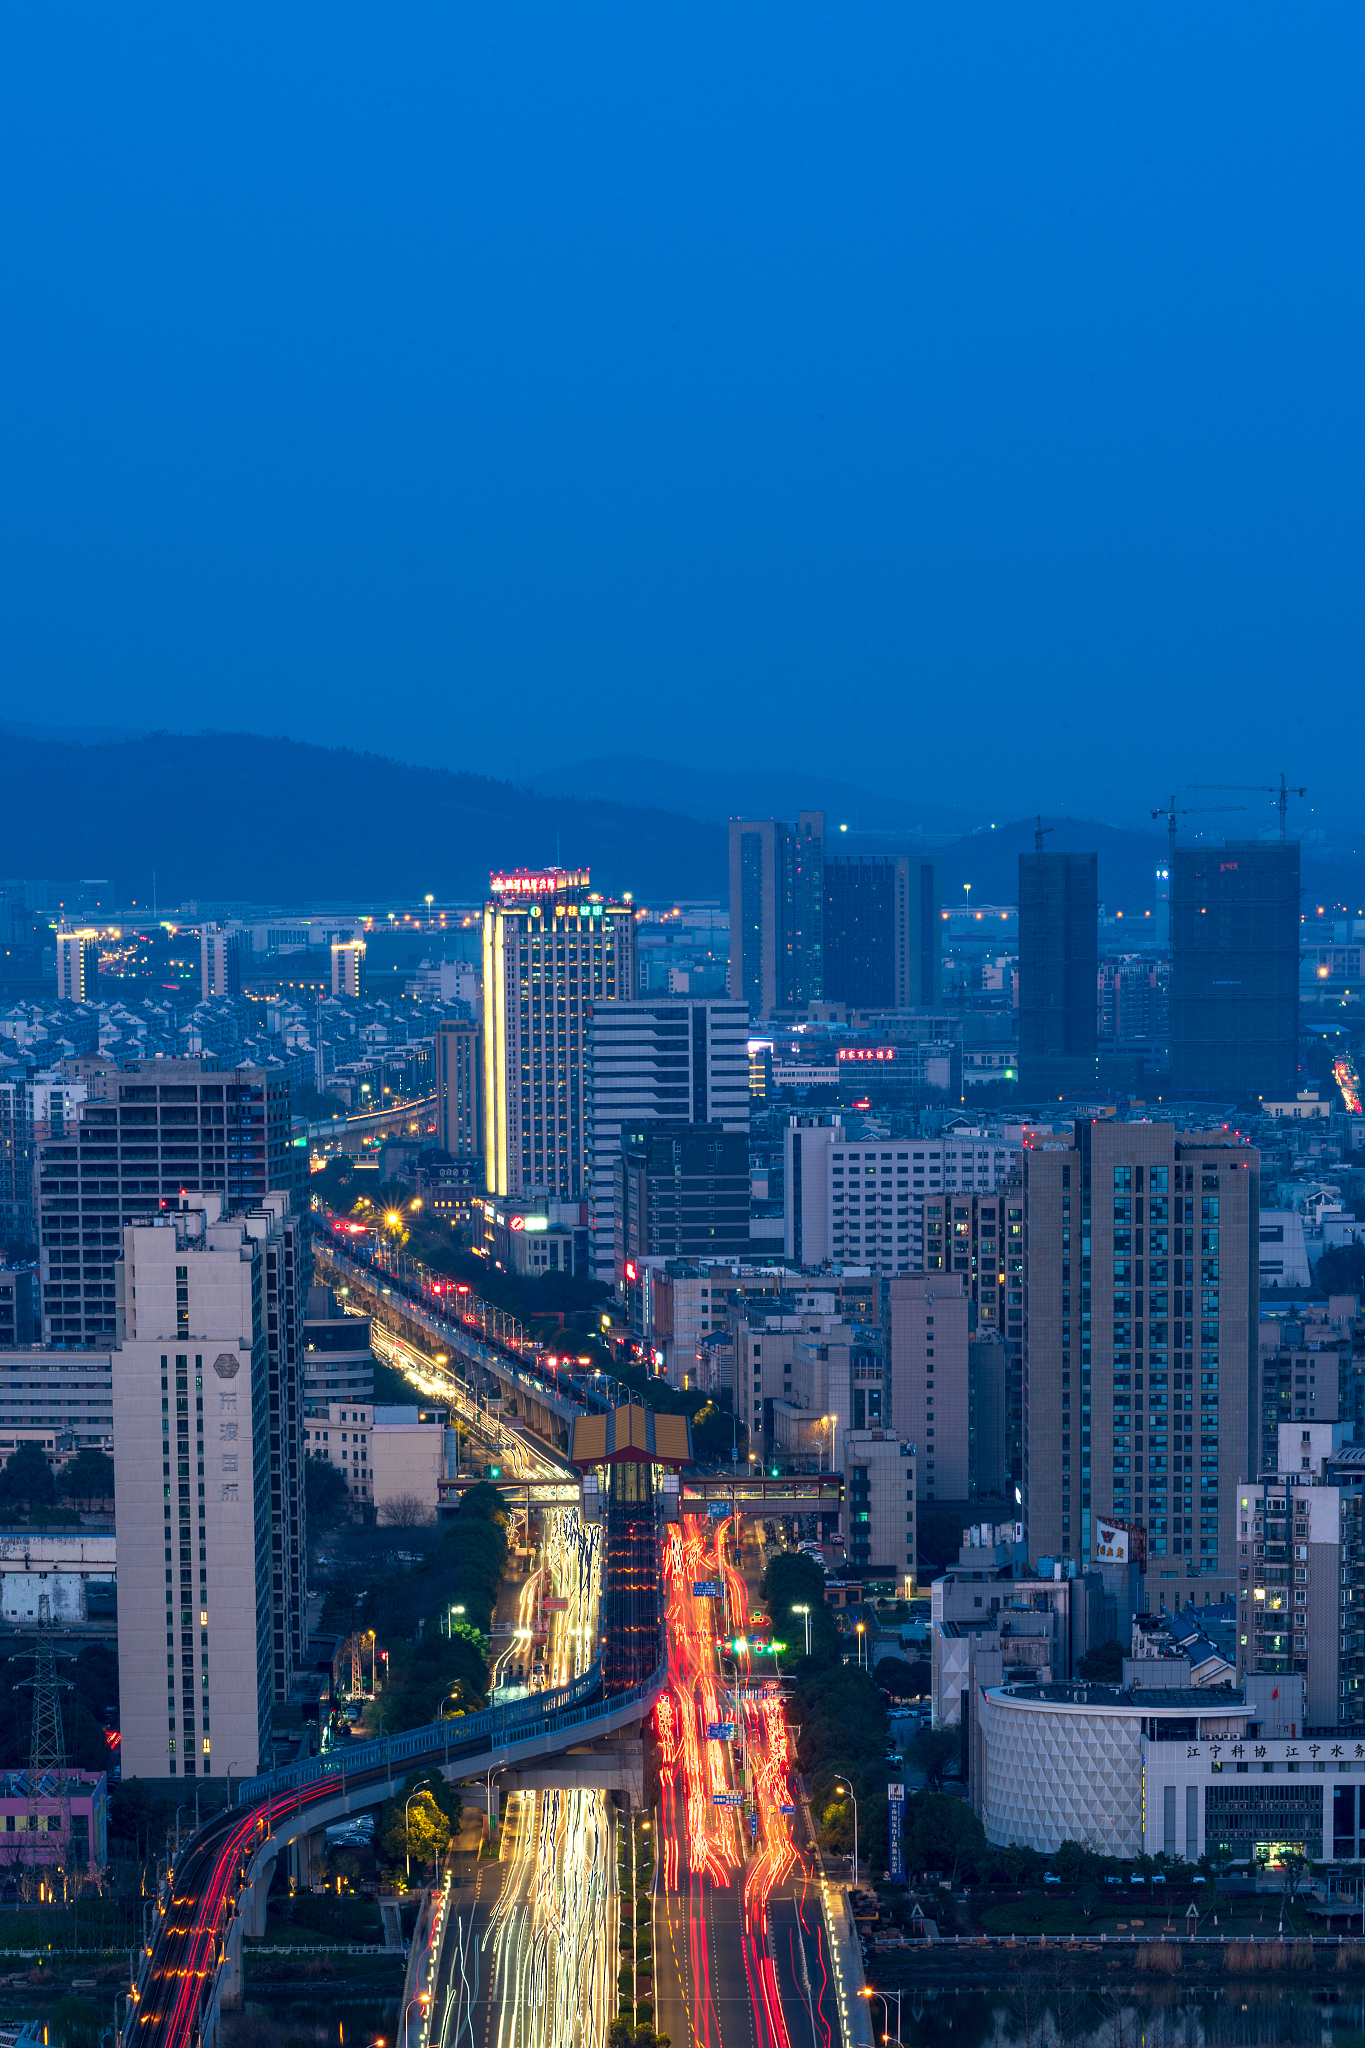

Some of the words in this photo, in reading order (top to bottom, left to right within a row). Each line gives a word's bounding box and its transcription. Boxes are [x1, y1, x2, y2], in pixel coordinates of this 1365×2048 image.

[555, 905, 603, 917] 享佳健康
[220, 1391, 239, 1501] 东渡国际
[1187, 1744, 1267, 1759] 江宁科协
[1285, 1743, 1365, 1759] 江宁水务
